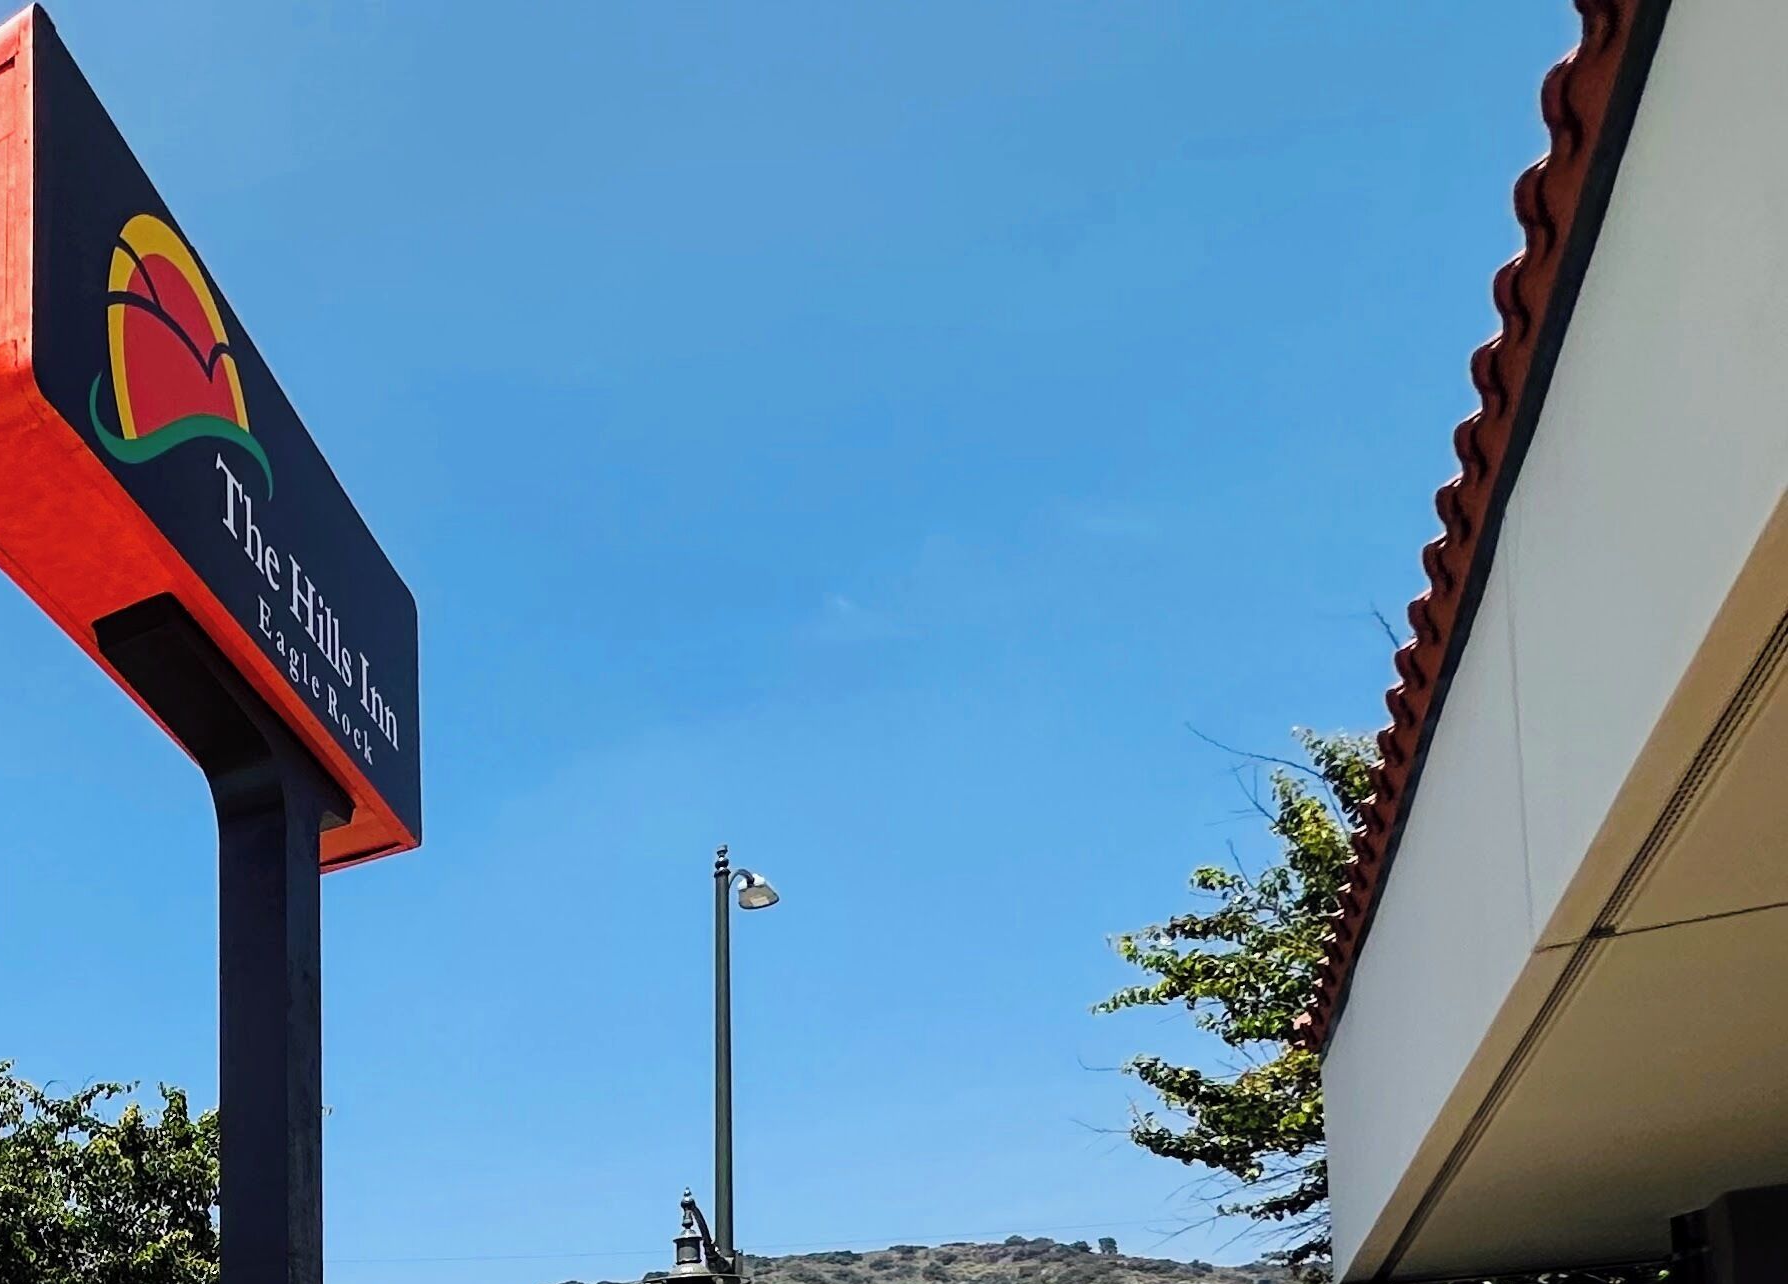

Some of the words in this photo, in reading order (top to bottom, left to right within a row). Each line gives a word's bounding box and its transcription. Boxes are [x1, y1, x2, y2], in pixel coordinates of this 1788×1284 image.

[215, 451, 281, 592] The
[288, 552, 353, 688] Hills
[359, 651, 399, 752] Inn
[257, 593, 320, 699] Eagle
[326, 683, 373, 766] Rock
